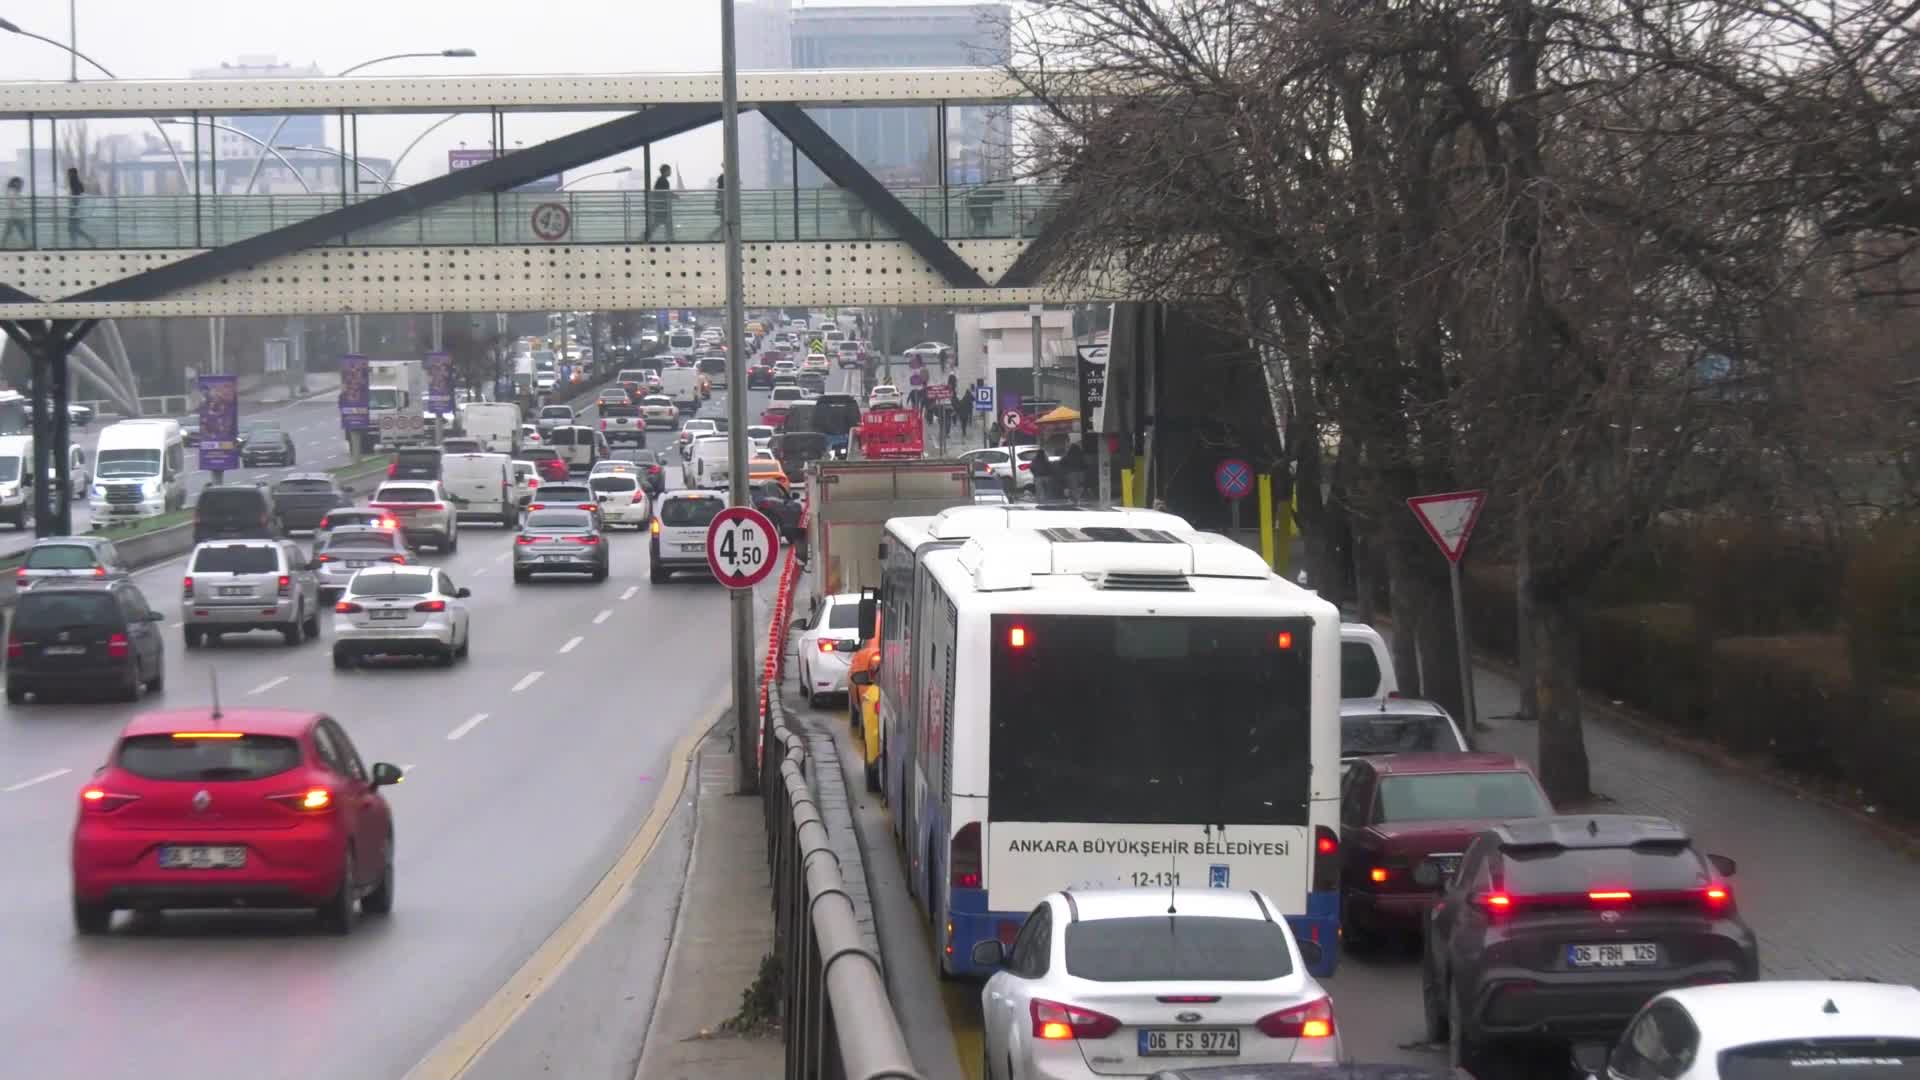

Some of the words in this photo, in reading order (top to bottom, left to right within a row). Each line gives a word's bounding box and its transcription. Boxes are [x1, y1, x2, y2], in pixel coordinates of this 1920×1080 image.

[742, 529, 754, 541] m
[1009, 840, 1078, 853] ANKARA
[1083, 839, 1189, 857] BÜYÜKŞEHİR
[1194, 841, 1289, 856] BELEDİYESİ
[1131, 872, 1180, 887] 12-131
[1576, 946, 1592, 961] 06
[1150, 1033, 1166, 1048] 06
[1176, 1033, 1193, 1049] FS
[1201, 1033, 1236, 1048] 9774
